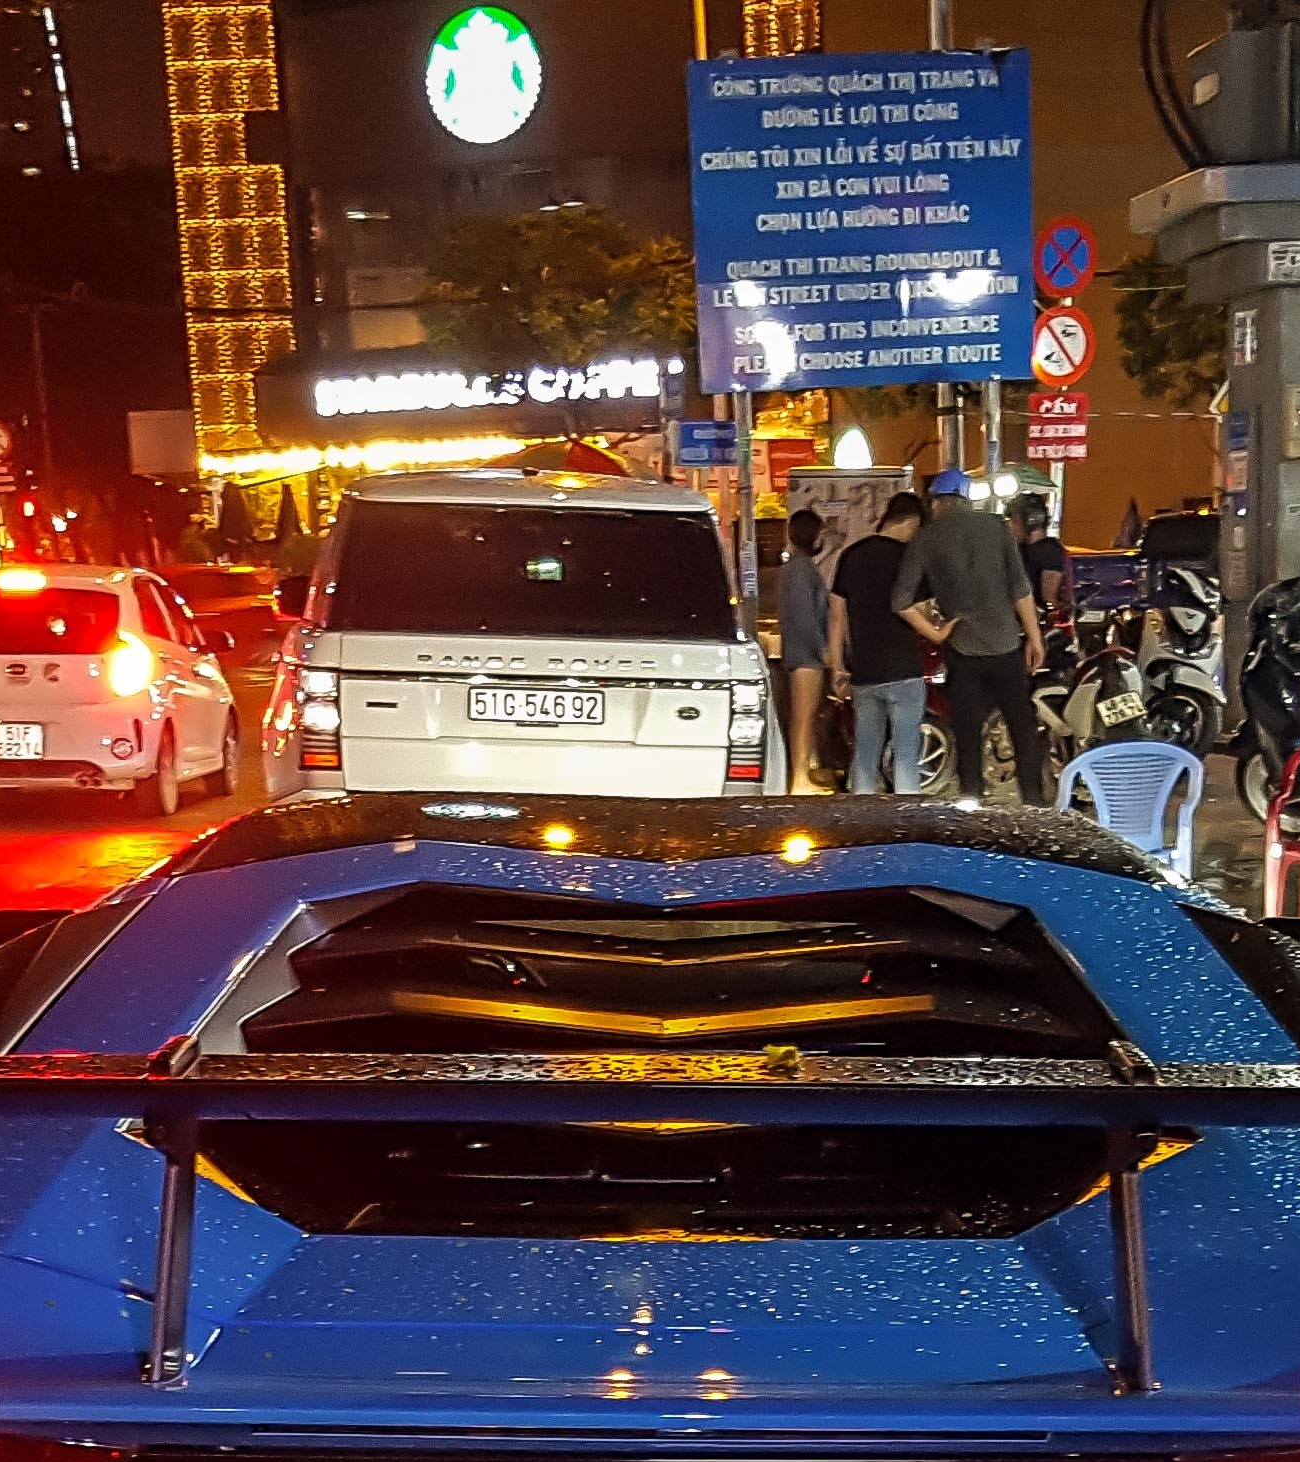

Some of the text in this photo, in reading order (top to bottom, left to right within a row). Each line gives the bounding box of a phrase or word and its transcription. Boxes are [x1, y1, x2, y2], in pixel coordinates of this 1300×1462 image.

[920, 69, 974, 90] TRANG
[793, 147, 822, 166] XIN
[835, 177, 870, 197] CON
[726, 248, 1001, 280] QUACH THI TRANG ROUNDABOUT &
[769, 284, 831, 305] STREET
[836, 281, 891, 302] UNDER
[794, 323, 826, 342] FOR
[829, 320, 867, 341] THIS
[871, 314, 1000, 338] INCONVENIENCE
[733, 343, 1001, 375] PLE CHOOSE ANOTHER ROUTE
[417, 653, 528, 670] RANGE
